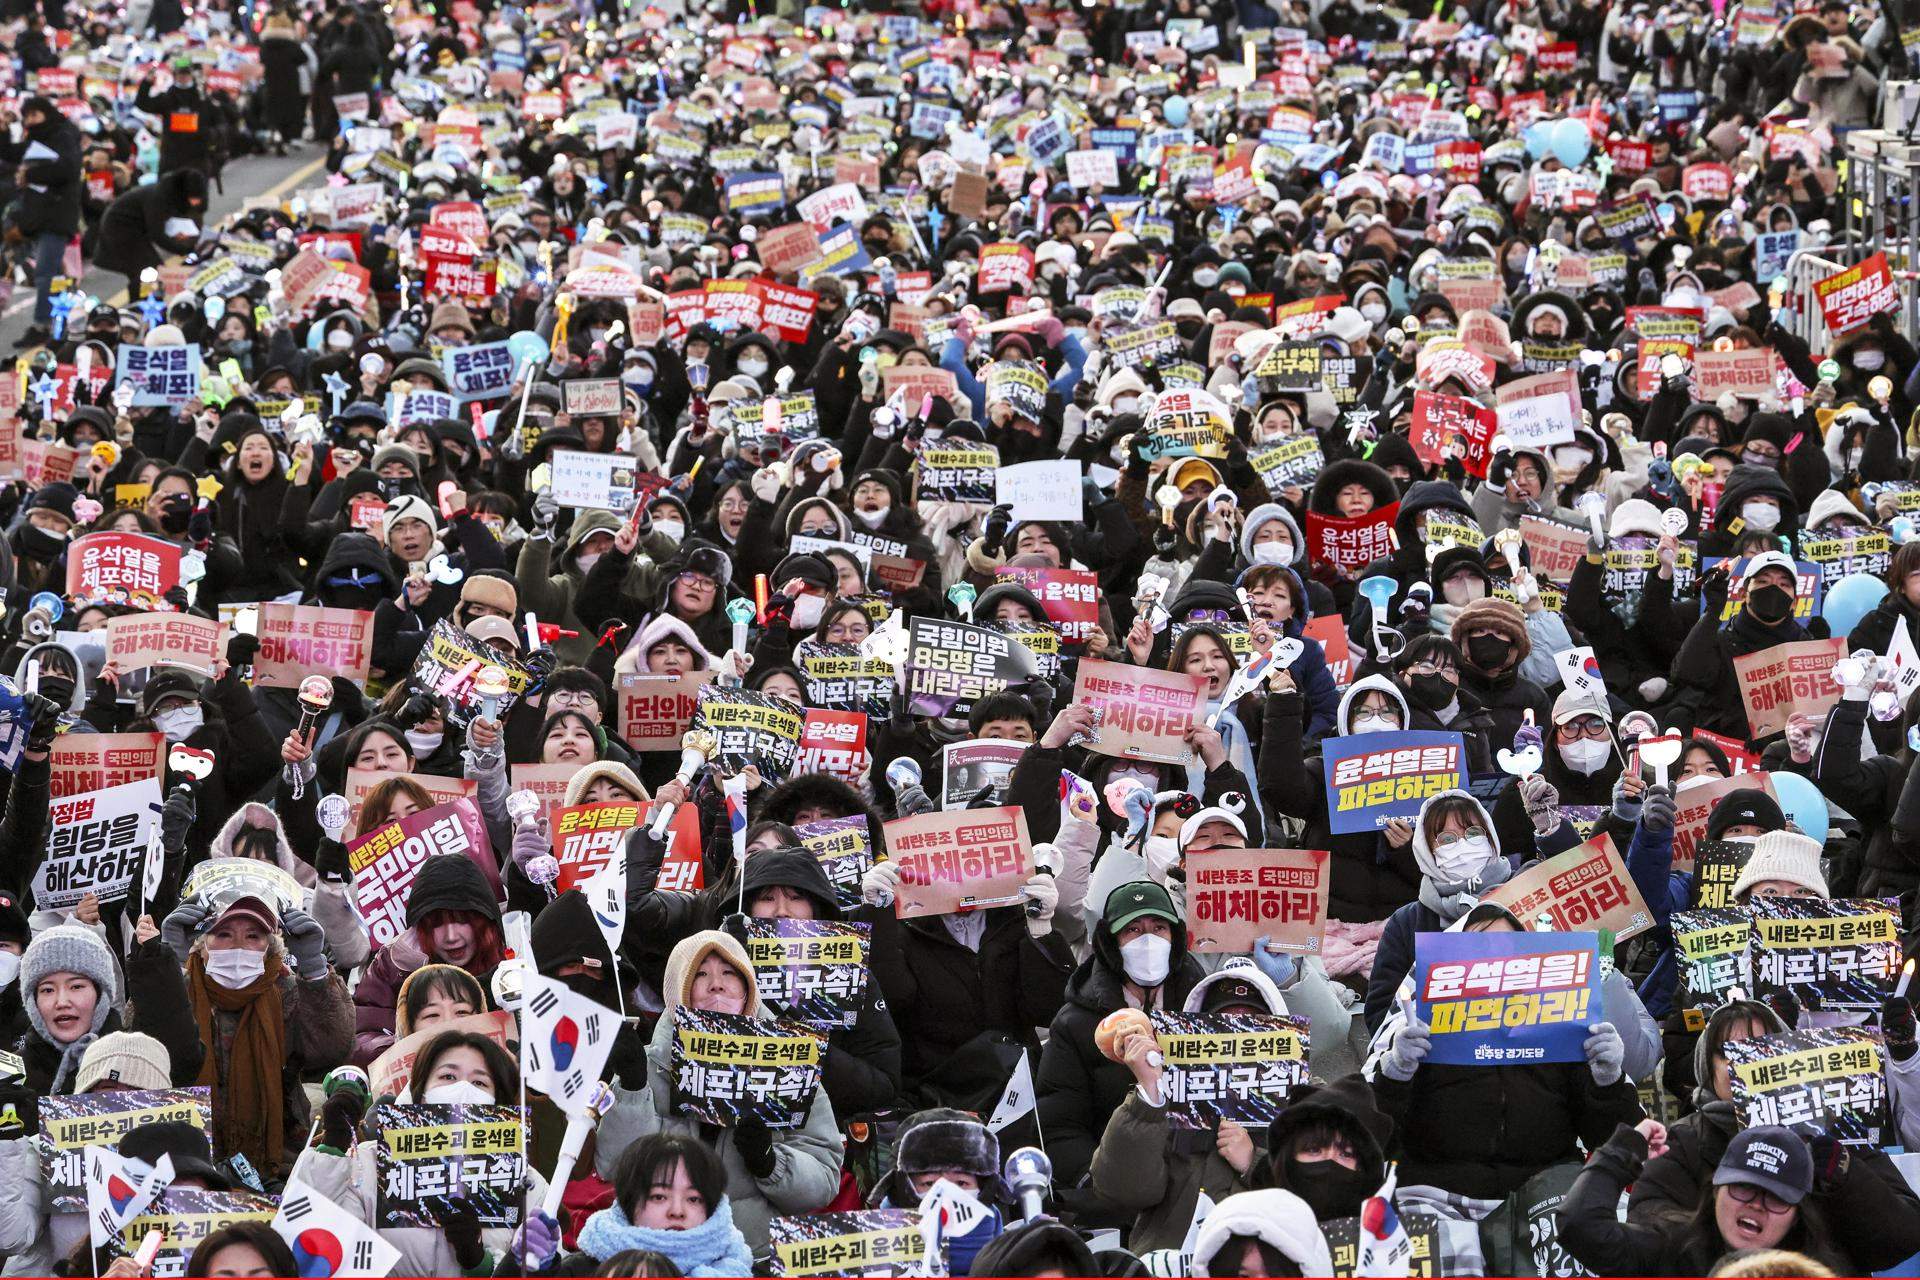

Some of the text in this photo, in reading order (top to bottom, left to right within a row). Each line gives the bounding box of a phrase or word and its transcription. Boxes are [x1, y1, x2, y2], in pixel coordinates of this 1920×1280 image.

[1824, 271, 1884, 311] 파면하고
[128, 350, 188, 371] 윤석열
[454, 347, 511, 372] 윤석열
[148, 374, 195, 395] 체포!
[464, 369, 511, 394] 체포!
[1702, 369, 1771, 387] 해체하라
[1158, 393, 1191, 412] 석열
[1426, 407, 1487, 441] 박근혜는
[930, 452, 967, 465] 내란수괴
[1256, 448, 1289, 469] 내란수괴
[1322, 520, 1390, 548] 윤석열을
[1811, 538, 1884, 557] 내란수괴 윤석열
[82, 545, 161, 574] 윤석열을
[1322, 540, 1392, 566] 체포하라
[1612, 552, 1654, 565] 내란수괴
[81, 566, 162, 595] 체포하라
[1046, 581, 1096, 603] 윤석열
[115, 621, 216, 640] 내란동조 국민의힘
[264, 619, 363, 639] 내란동조 국민의힘
[917, 623, 1009, 657] 국힘의원
[112, 634, 220, 658] 해체하라
[261, 637, 364, 669] 해체하라
[813, 661, 861, 674] 내란수괴
[914, 647, 995, 677] 85명은
[1746, 653, 1838, 682] 내란동조 국민의힘
[1084, 676, 1195, 709] 내란동조 국민의힘
[1749, 668, 1842, 713] 해체하라
[711, 707, 797, 736] 내란수괴 윤석열
[806, 721, 860, 743] 윤석열
[108, 751, 154, 766] 국민의힘
[1335, 746, 1458, 785] 윤석열을!
[1337, 773, 1459, 812] 파면하라!
[559, 807, 638, 834] 윤석열을
[48, 812, 139, 860] 힘당을
[896, 826, 1014, 851] 내란동조 국민의힘
[356, 812, 471, 905] 국민의힘
[898, 843, 1025, 887] 해체하라
[1197, 870, 1317, 886] 내란동조 국민의힘
[1554, 859, 1608, 892] 국민의힘
[1195, 890, 1320, 925] 해체하라
[1768, 918, 1888, 943] 내란수괴 윤석열
[806, 939, 854, 960] 윤석열
[1427, 952, 1589, 998] 윤석열을!
[1758, 946, 1897, 988] 체포!구속!
[1430, 988, 1588, 1035] 파면하라!
[690, 1038, 812, 1062] 내란수괴 윤석열
[1169, 1036, 1292, 1059] 내란수괴 윤석열
[1506, 1046, 1545, 1058] 경기도당
[1751, 1048, 1871, 1087] 내란수괴 윤석열
[677, 1064, 818, 1104] 체포!구속!
[1162, 1066, 1302, 1104] 체포!구속!
[1744, 1077, 1881, 1128] 체포!구속!
[61, 1117, 134, 1144] 내란수괴
[396, 1127, 517, 1155] 내란수괴 윤석열
[1746, 1142, 1788, 1164] BROOKLYN
[1747, 1159, 1780, 1174] NEW YORK
[385, 1157, 523, 1201] 체포!구속!
[791, 1235, 868, 1270] 내란수괴
